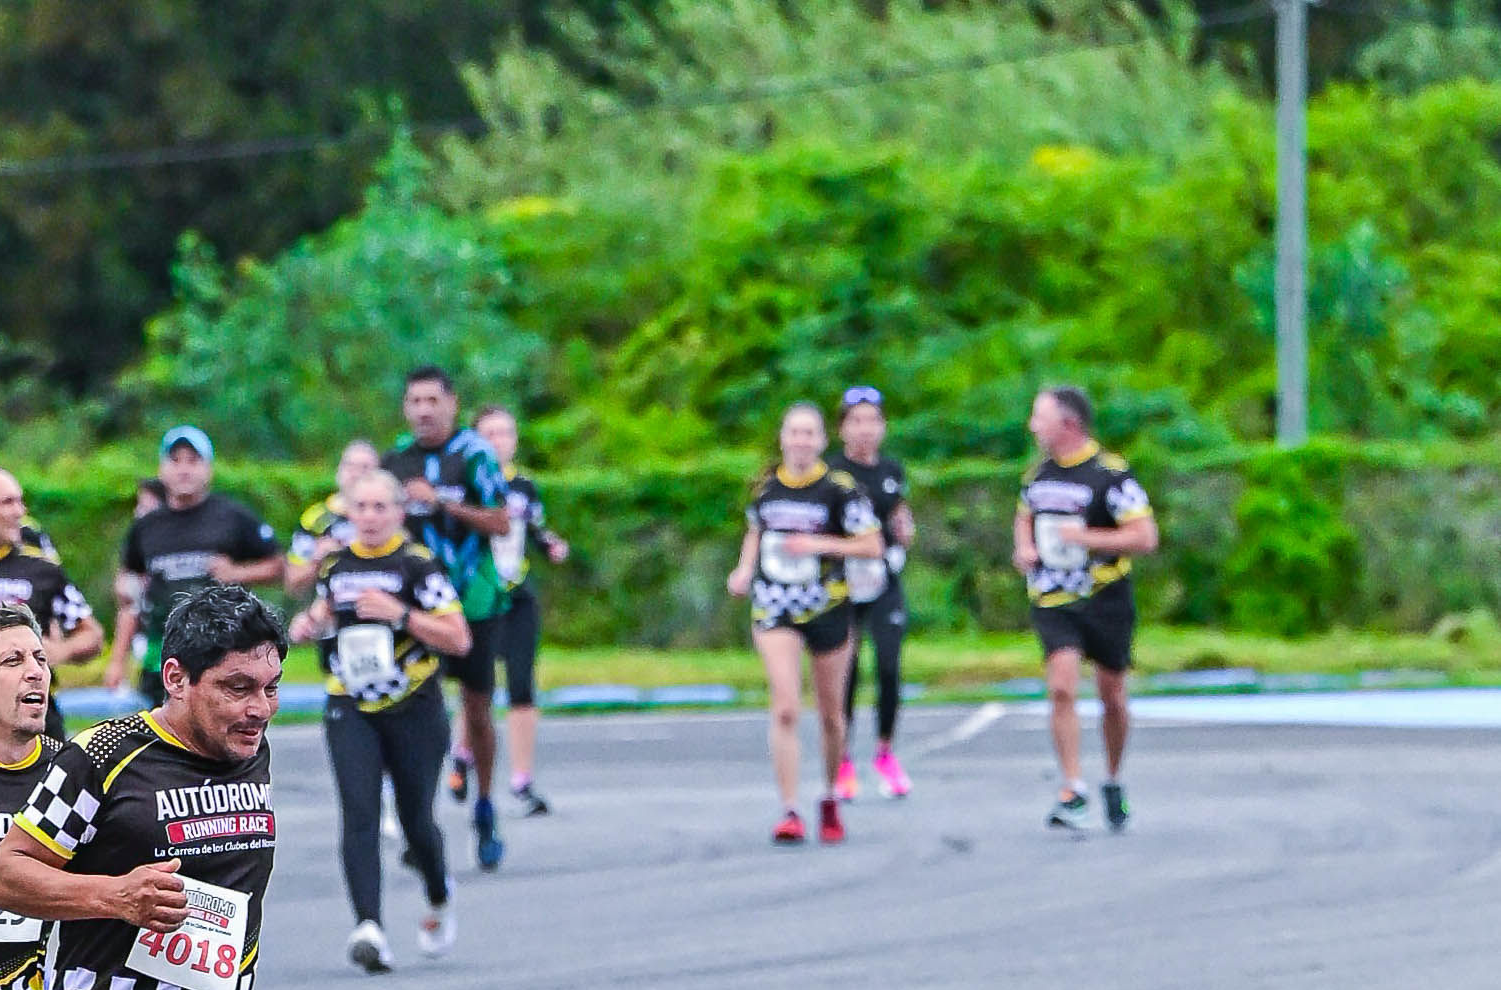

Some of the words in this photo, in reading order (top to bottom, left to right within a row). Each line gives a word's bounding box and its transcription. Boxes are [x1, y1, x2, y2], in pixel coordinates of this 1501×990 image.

[155, 778, 273, 821] AUTÓDROM
[182, 817, 237, 841] RUNNING
[240, 816, 269, 833] RACE
[154, 847, 166, 857] La
[168, 845, 200, 857] Carrera
[202, 843, 212, 854] de
[138, 930, 237, 979] 4018
